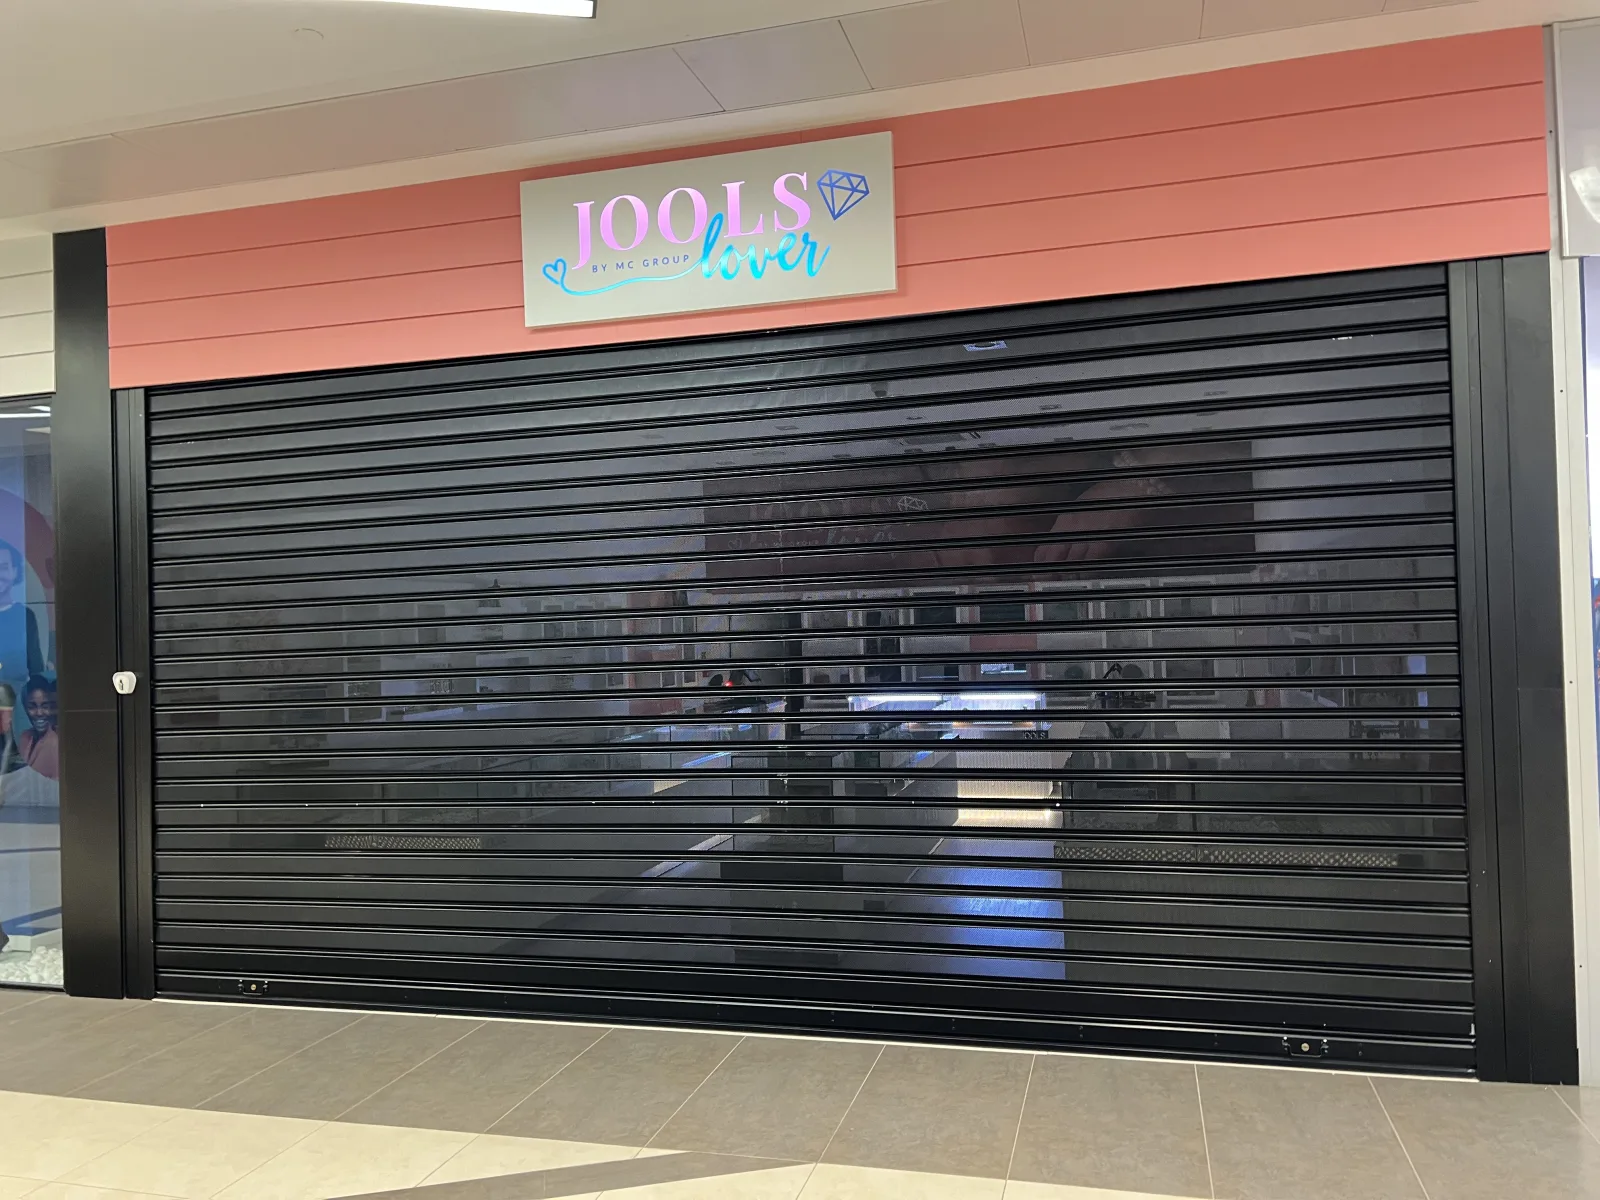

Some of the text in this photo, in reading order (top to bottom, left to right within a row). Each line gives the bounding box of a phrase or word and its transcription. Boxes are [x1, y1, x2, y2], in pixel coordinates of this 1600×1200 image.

[571, 171, 811, 270] JOOLS
[700, 212, 831, 280] lover
[592, 254, 691, 273] BY MC GROUP
